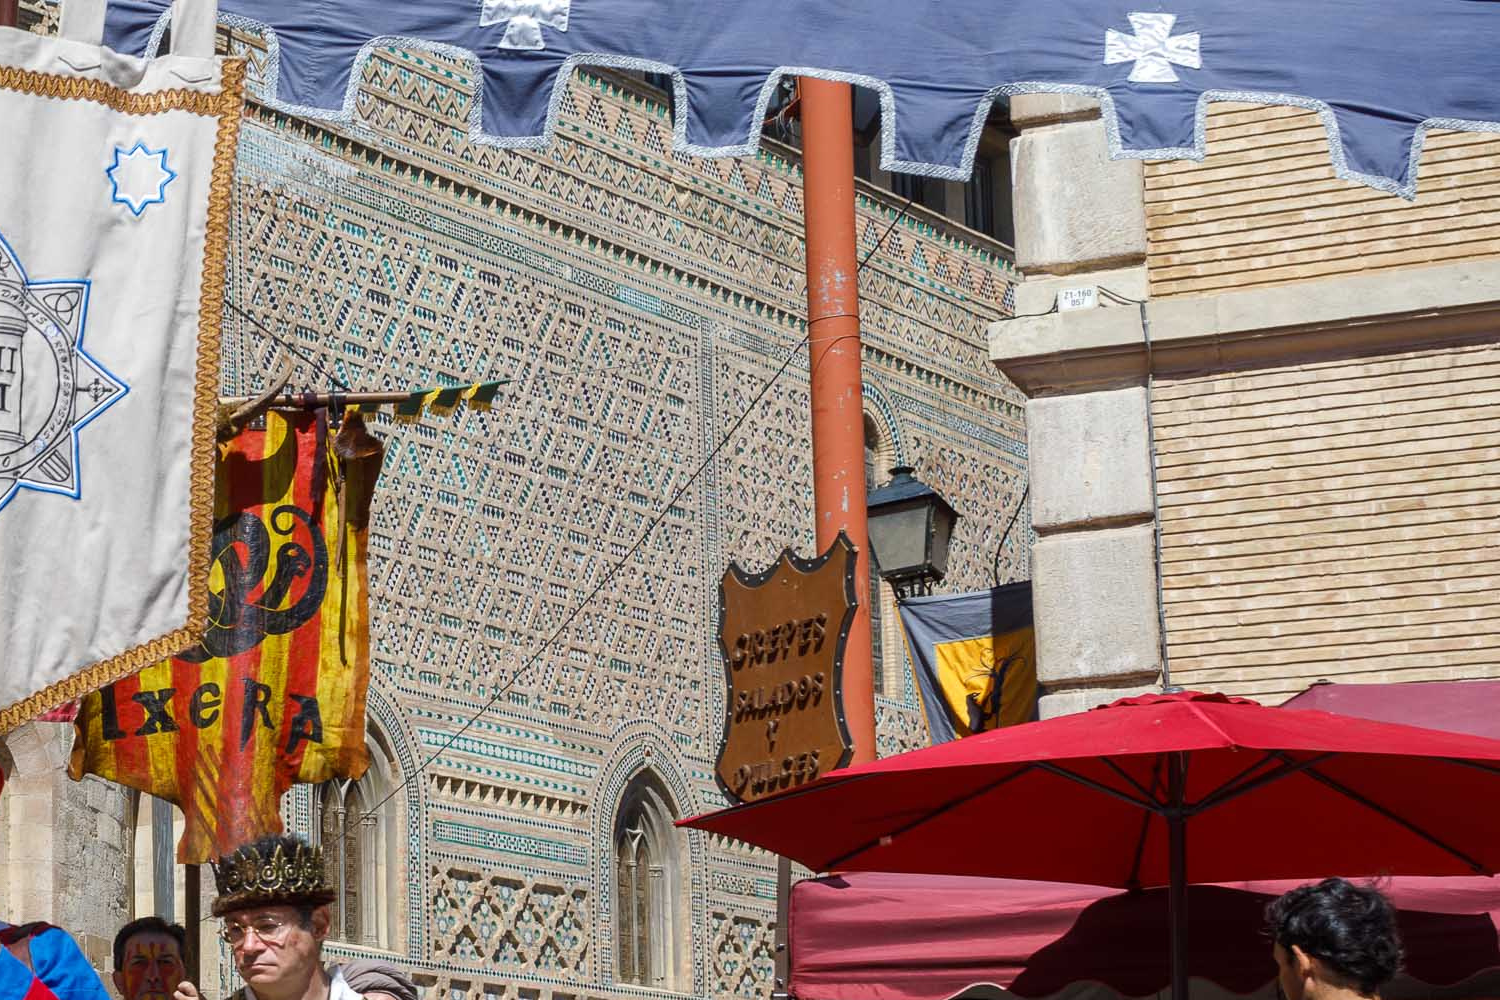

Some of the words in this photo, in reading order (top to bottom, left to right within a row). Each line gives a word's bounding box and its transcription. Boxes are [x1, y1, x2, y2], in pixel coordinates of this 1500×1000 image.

[731, 613, 827, 672] CREPES
[735, 672, 824, 724] SALADOS
[734, 749, 820, 797] DULCES
